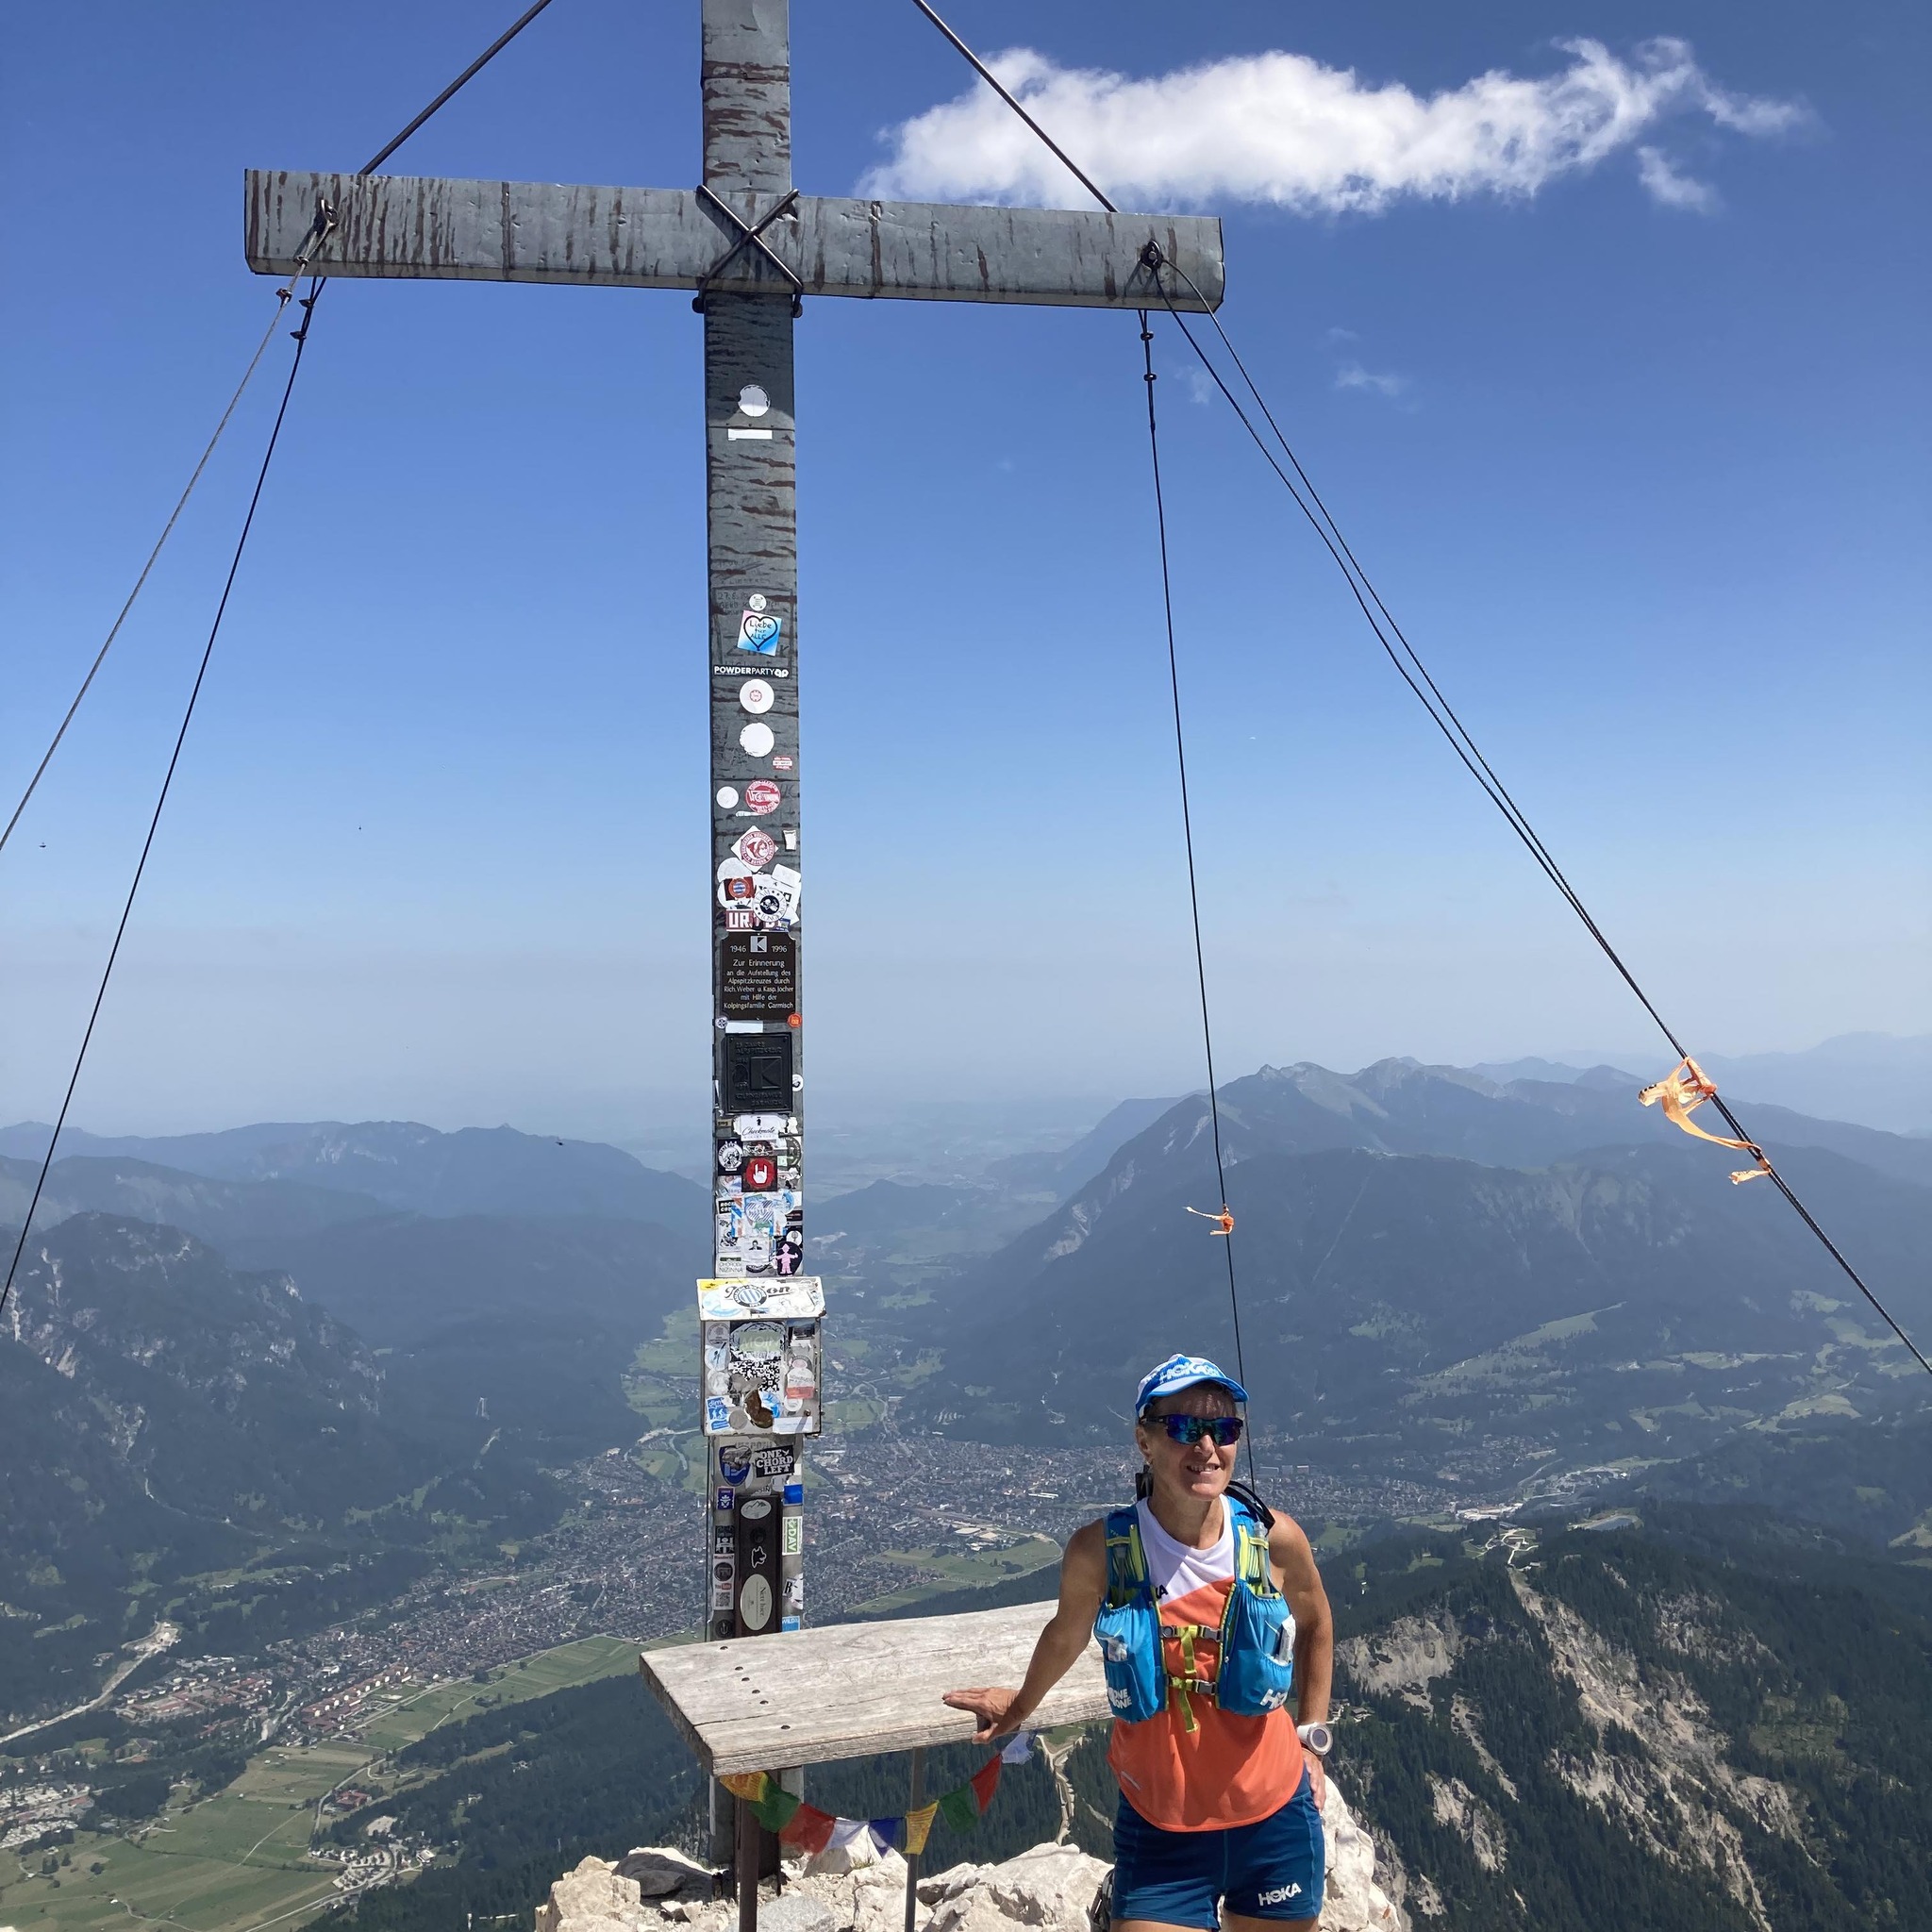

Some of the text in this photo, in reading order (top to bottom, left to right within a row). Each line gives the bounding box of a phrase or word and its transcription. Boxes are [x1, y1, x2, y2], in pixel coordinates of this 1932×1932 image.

[748, 959, 785, 968] Erinnerung
[724, 1002, 766, 1010] Kolpingsfamilie
[760, 1449, 783, 1459] ONE
[756, 1456, 793, 1468] CHORD
[763, 1463, 791, 1475] LEFT
[788, 1528, 797, 1552] DAV
[1257, 1882, 1303, 1907] HOKA
